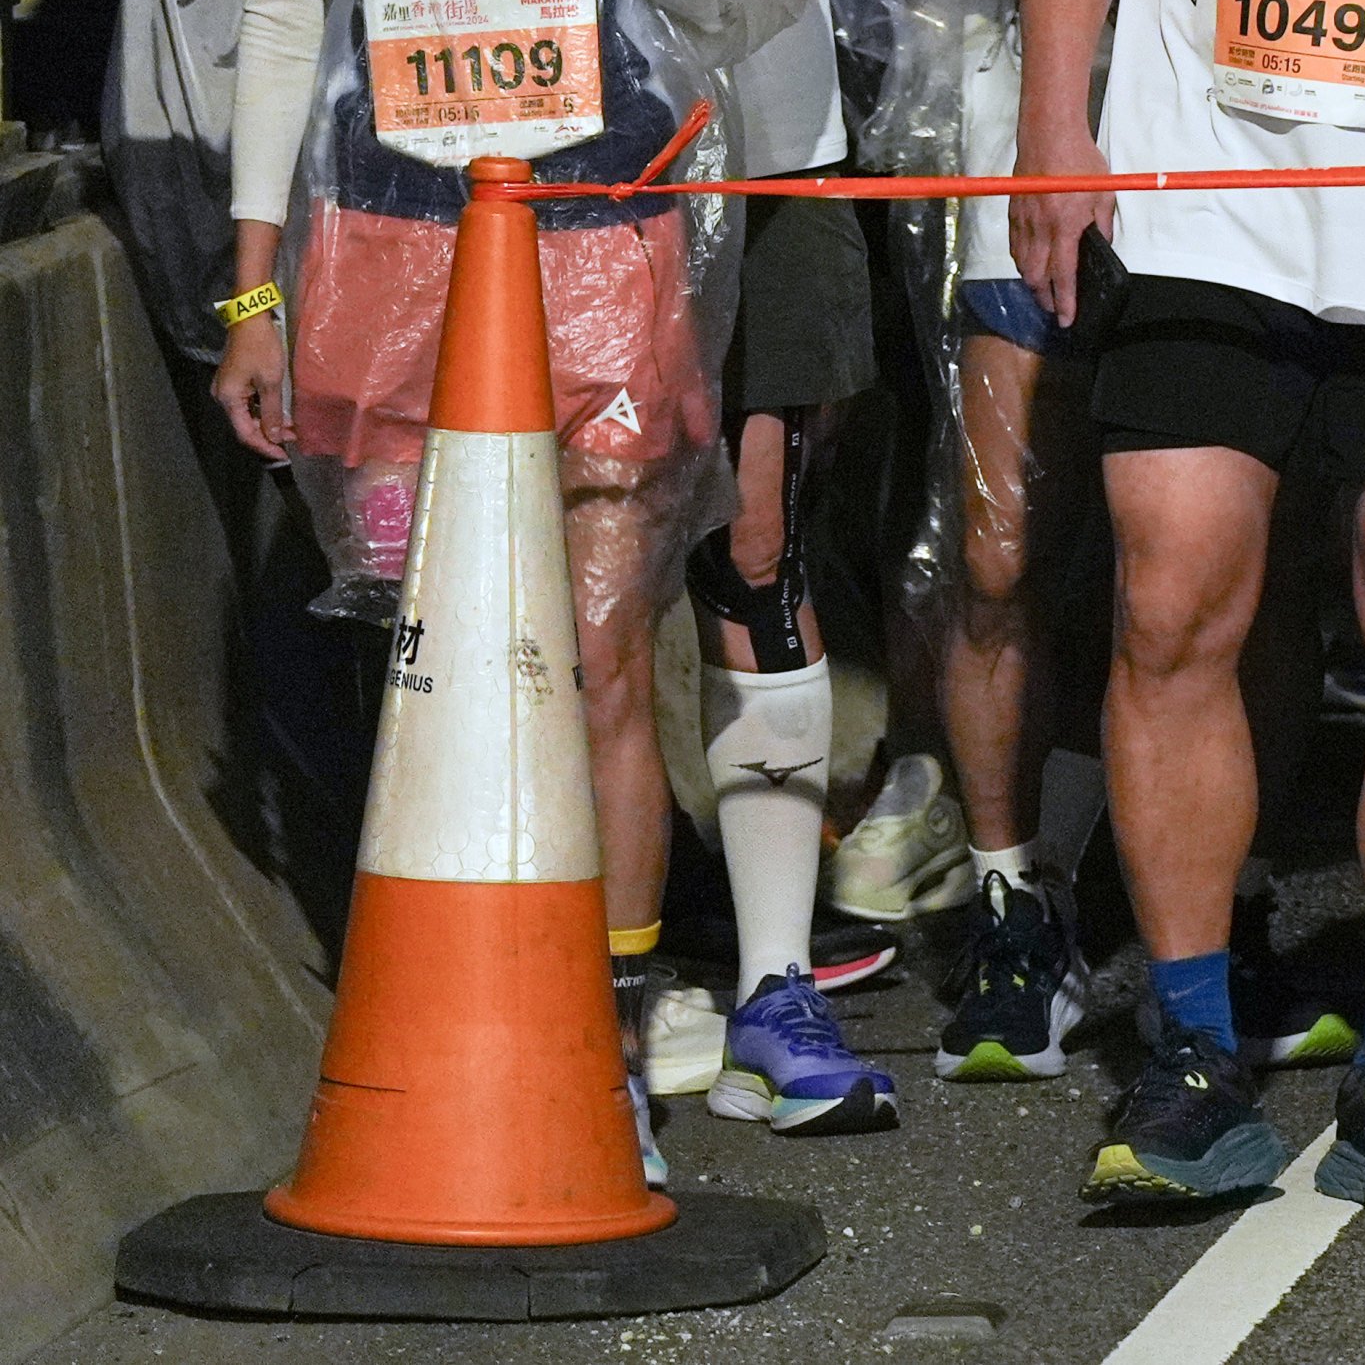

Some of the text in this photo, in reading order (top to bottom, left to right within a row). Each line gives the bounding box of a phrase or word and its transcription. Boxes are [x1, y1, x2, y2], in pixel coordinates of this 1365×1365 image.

[467, 15, 490, 25] 2024
[407, 39, 563, 95] 11109
[1262, 54, 1301, 74] 05:15
[237, 287, 276, 317] A462
[397, 615, 425, 665] 材
[389, 669, 434, 694] GENIUS
